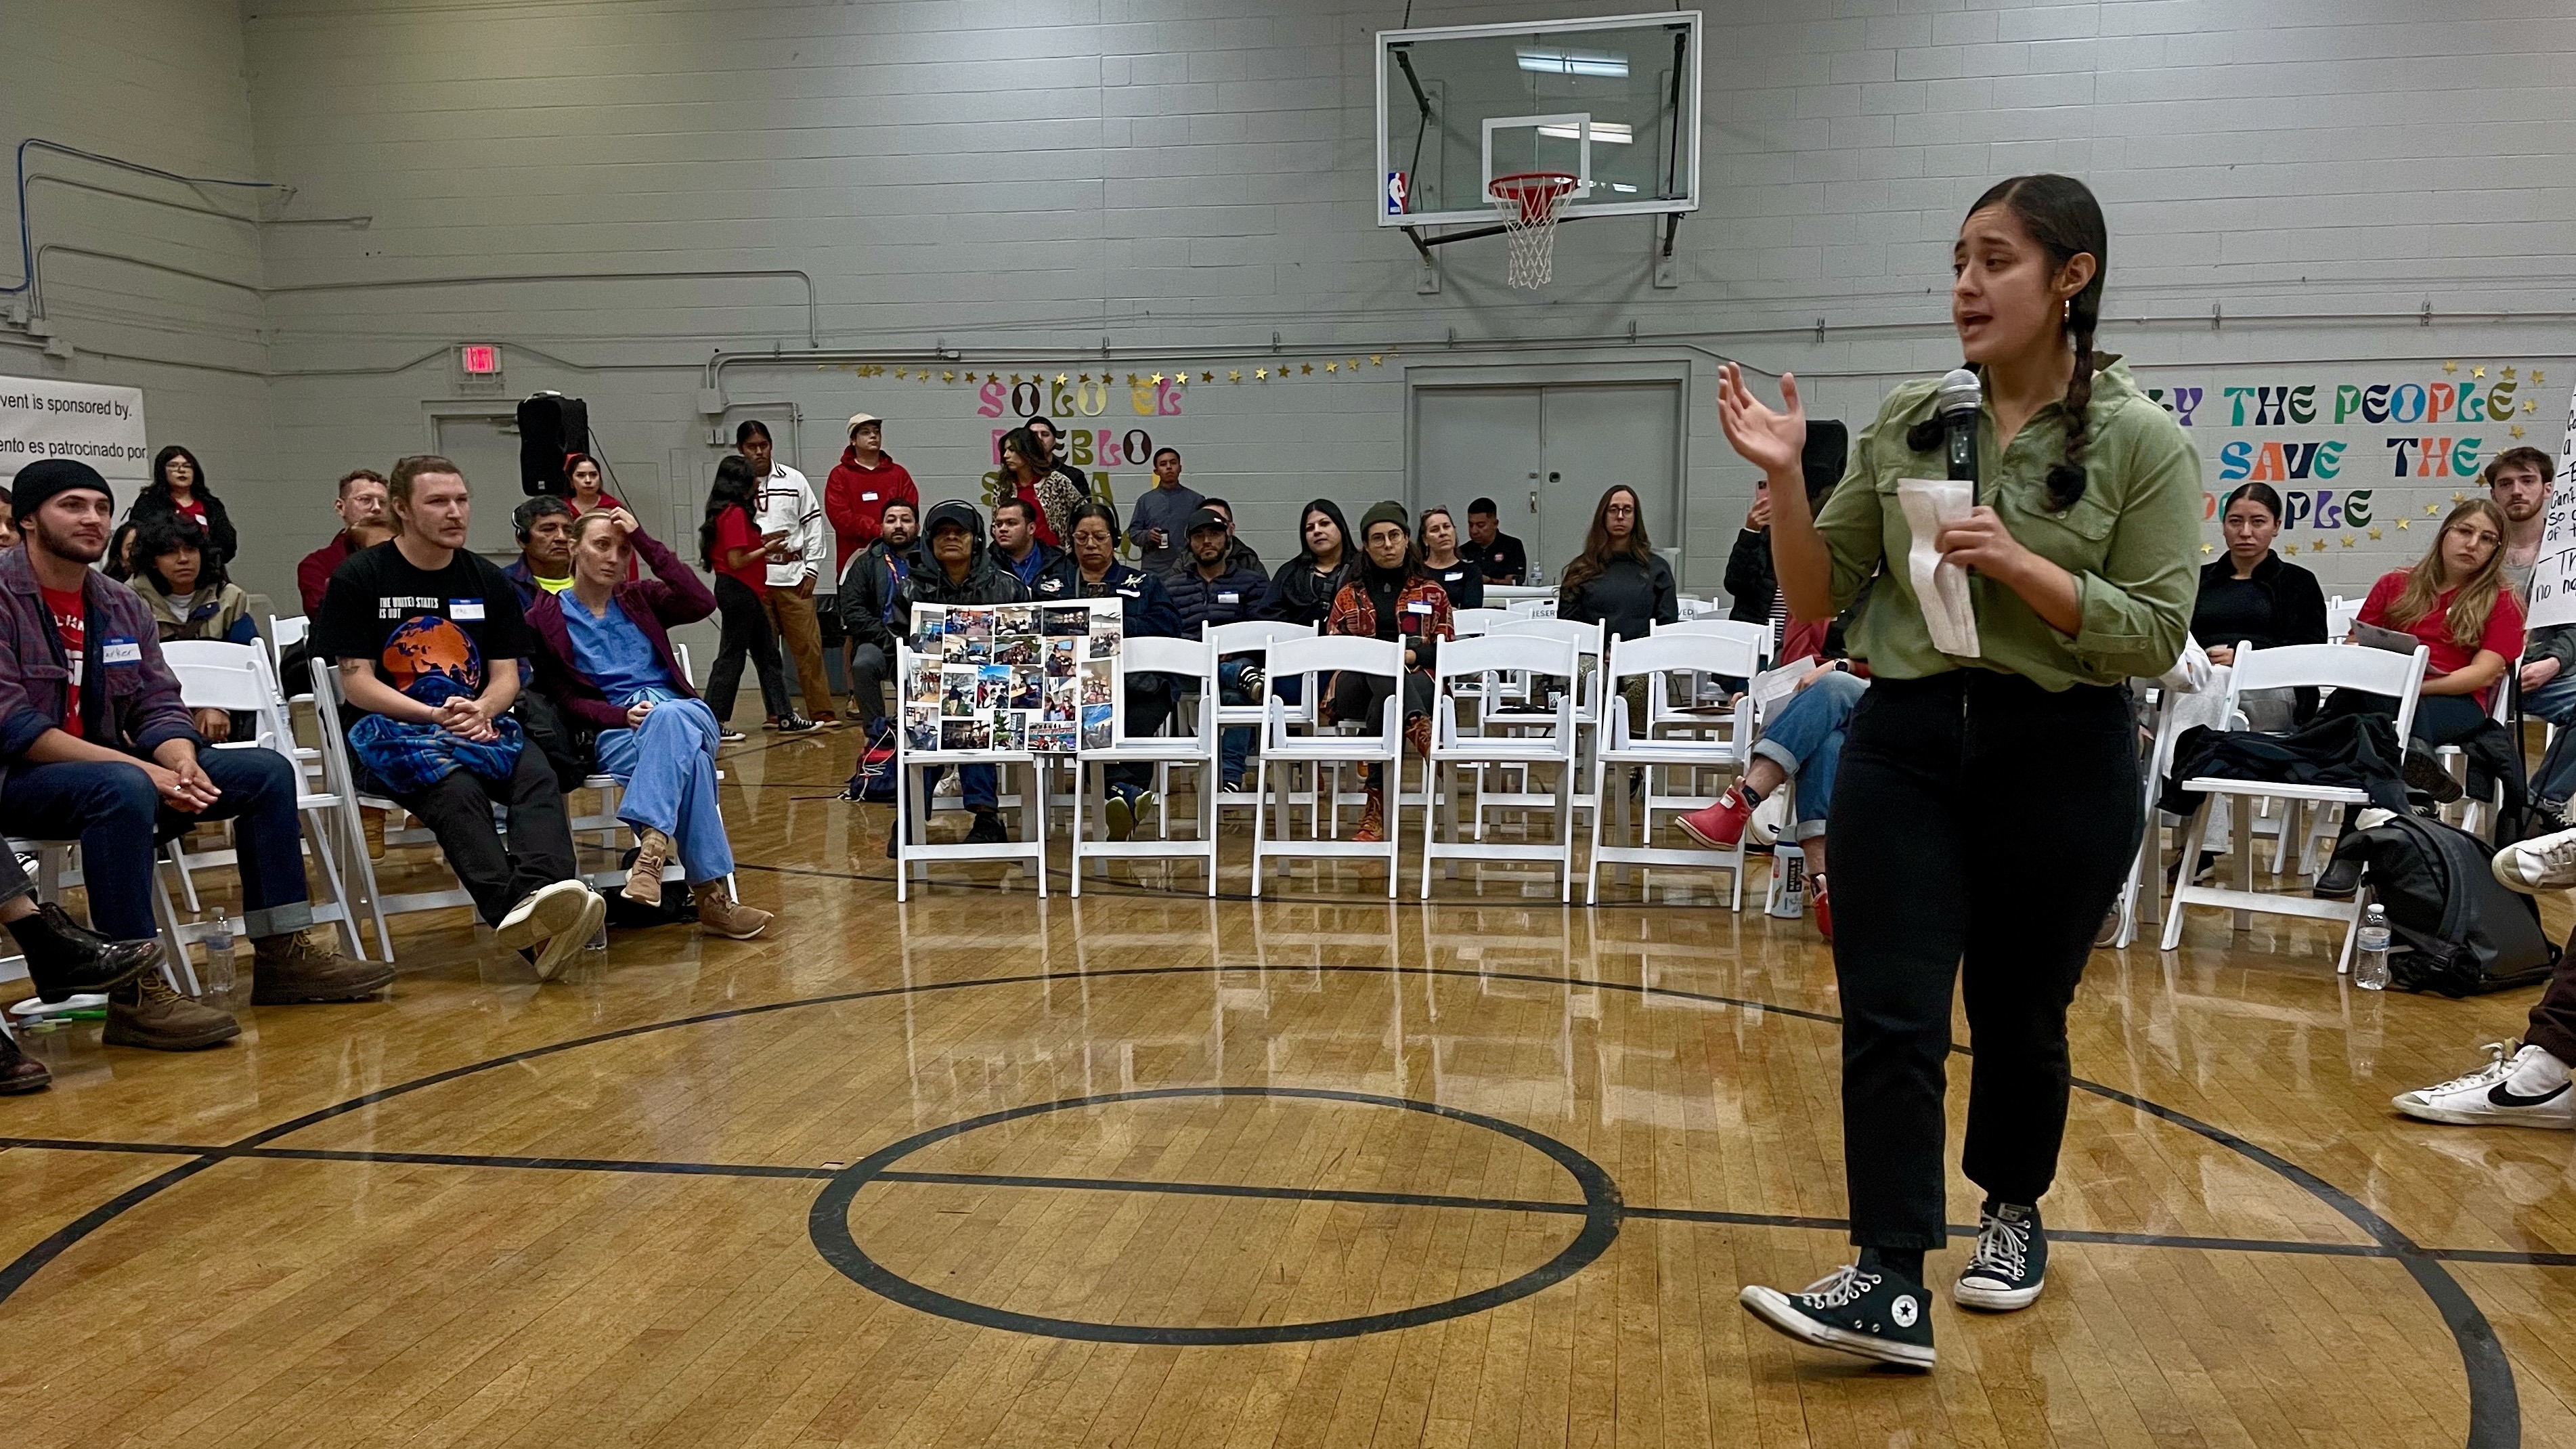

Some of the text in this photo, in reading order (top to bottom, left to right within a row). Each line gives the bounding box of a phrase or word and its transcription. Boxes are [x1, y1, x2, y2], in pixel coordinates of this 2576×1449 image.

[32, 393, 44, 410] is
[47, 398, 111, 415] sponsored
[114, 400, 132, 420] by.
[977, 378, 1183, 418] SOLO EL
[2223, 385, 2317, 427] THE
[2334, 382, 2517, 425] PEOPLE
[28, 441, 45, 454] es
[49, 440, 124, 457] patrocinado
[2219, 437, 2483, 481] SAVE THE
[2548, 512, 2565, 526] so
[2547, 526, 2560, 541] of
[380, 597, 391, 608] THE
[415, 597, 439, 609] STATES
[2536, 584, 2551, 603] no
